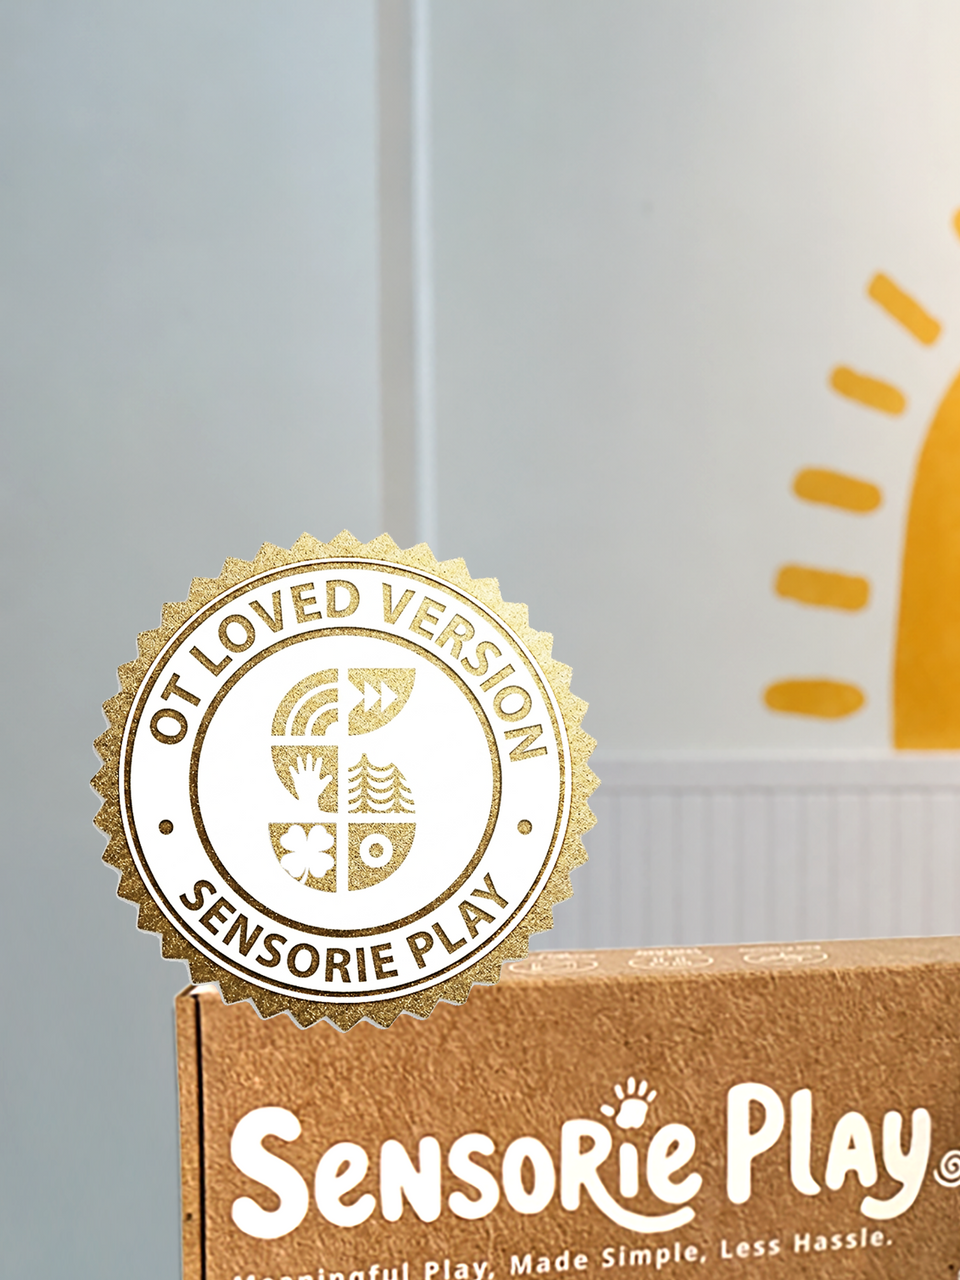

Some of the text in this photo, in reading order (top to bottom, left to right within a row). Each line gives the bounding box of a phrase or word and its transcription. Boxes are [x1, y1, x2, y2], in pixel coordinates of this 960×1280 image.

[510, 1250, 588, 1275] Made
[601, 1242, 707, 1269] Simple,
[721, 1239, 780, 1259] Less
[794, 1227, 894, 1254] Hassle.
